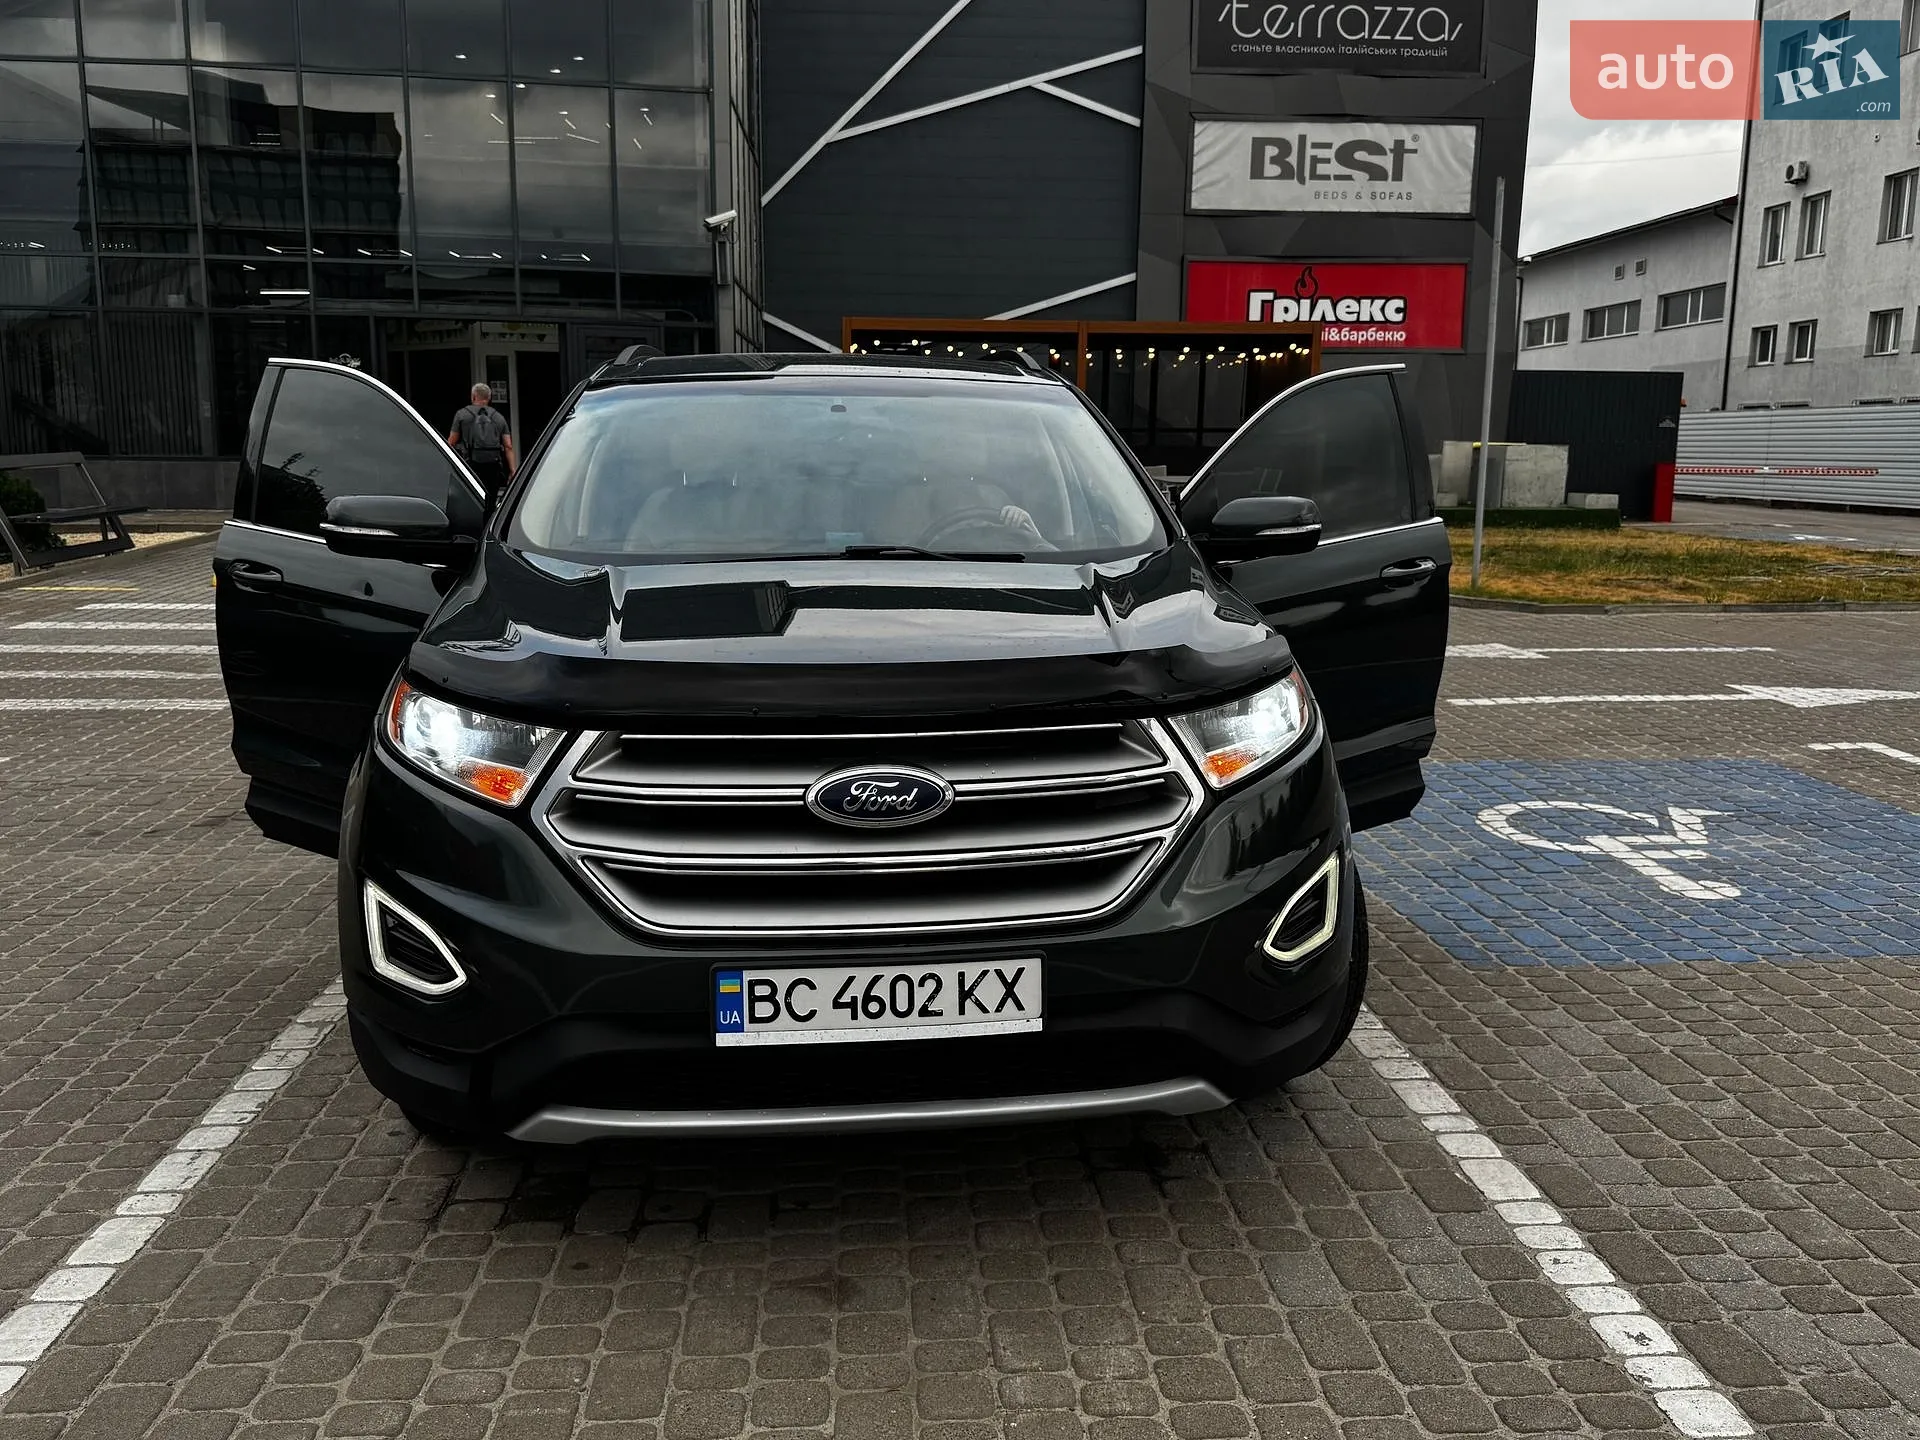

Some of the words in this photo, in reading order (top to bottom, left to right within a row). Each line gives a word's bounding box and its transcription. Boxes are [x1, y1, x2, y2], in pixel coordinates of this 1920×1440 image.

[1218, 0, 1463, 42] terrazza
[1230, 44, 1273, 53] станьте
[1275, 45, 1336, 54] власником
[1338, 44, 1397, 56] італійських
[1400, 46, 1448, 57] традицій
[1313, 191, 1348, 200] BEDS
[1354, 191, 1363, 200] &
[1370, 191, 1413, 201] SOFAS
[1247, 291, 1405, 323] Грілекс
[843, 780, 919, 812] Ford
[747, 977, 818, 1024] BC
[831, 972, 944, 1021] 4602
[957, 966, 1026, 1016] KX
[719, 1010, 741, 1025] UA
